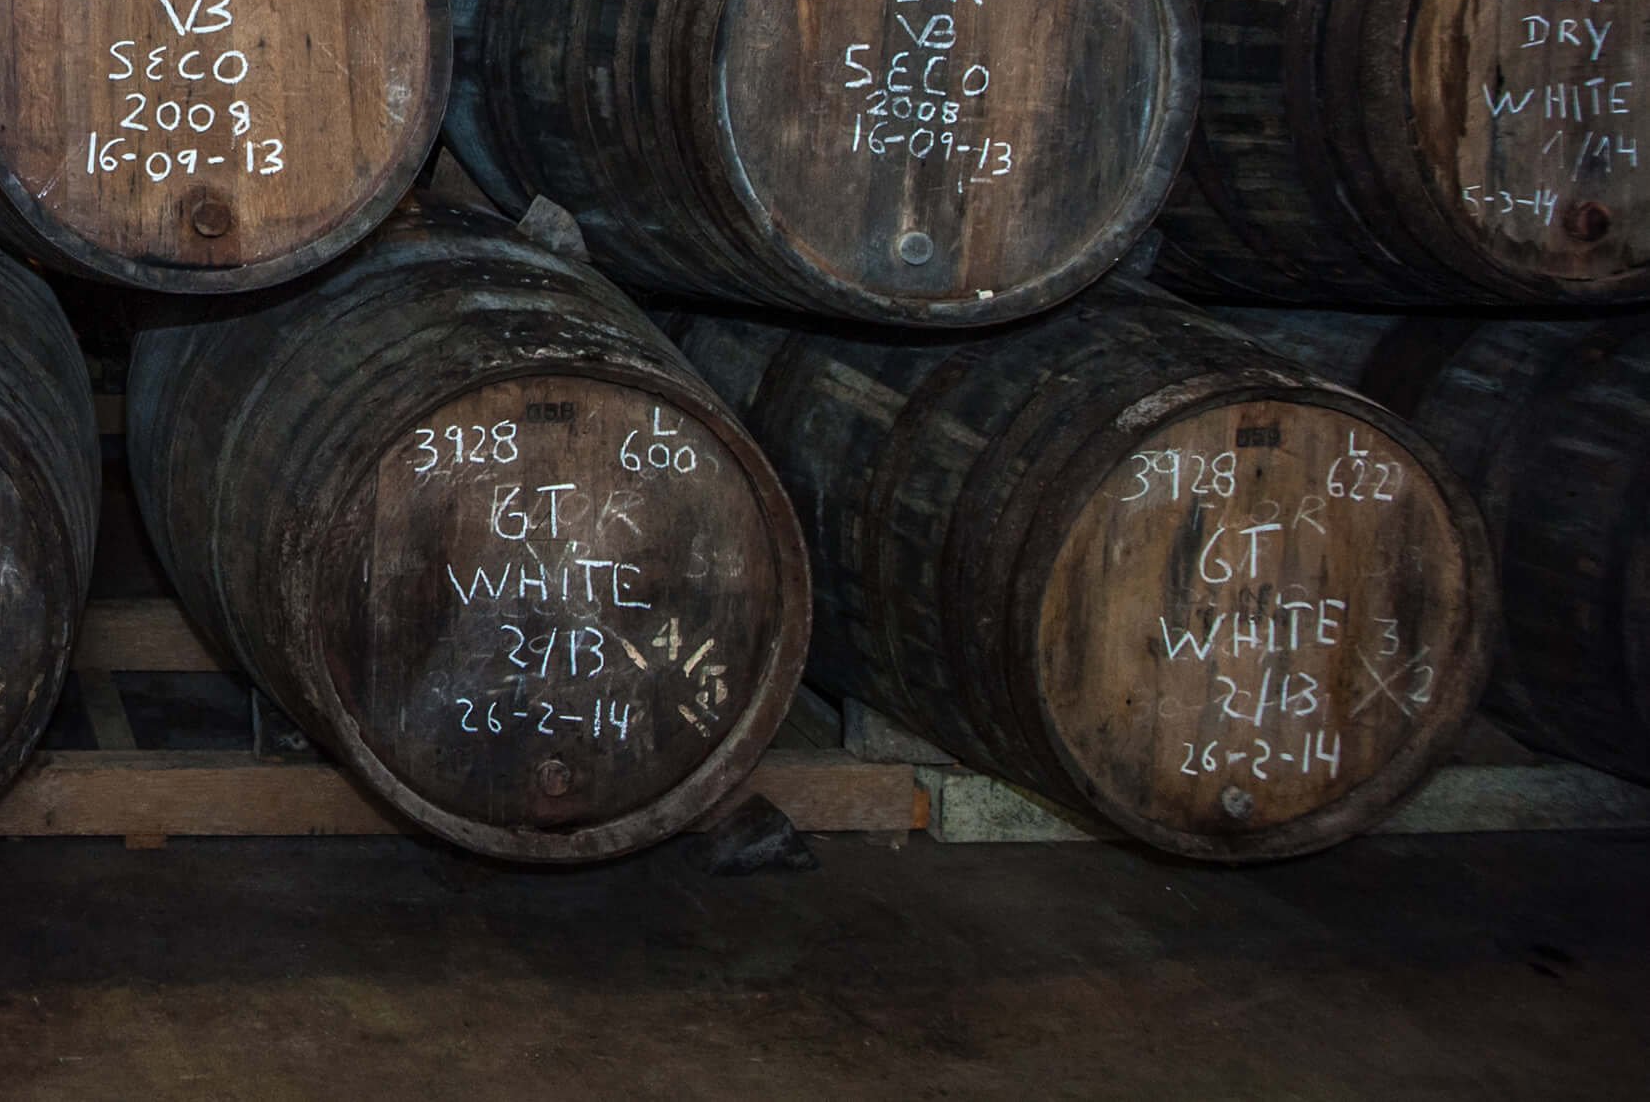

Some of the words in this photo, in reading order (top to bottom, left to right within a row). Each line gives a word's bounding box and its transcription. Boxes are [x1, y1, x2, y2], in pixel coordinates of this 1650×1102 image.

[895, 13, 957, 49] VB
[1521, 15, 1613, 61] DRY
[108, 40, 250, 84] SECO
[844, 43, 990, 97] SECO
[120, 93, 251, 136] 2008
[866, 89, 960, 124] 2008
[1482, 77, 1633, 122] WHITE
[86, 131, 284, 182] 16-09-13
[852, 113, 1012, 175] 16-09-13
[653, 406, 678, 436] L
[1349, 429, 1369, 457] L
[414, 420, 518, 473] 3928
[619, 429, 697, 474] 600
[1120, 448, 1237, 501] 3928
[446, 560, 651, 609] WHITE
[1159, 598, 1347, 661] WHITE
[456, 698, 631, 741] 26-2-14
[1179, 729, 1342, 780] 26-2-14
